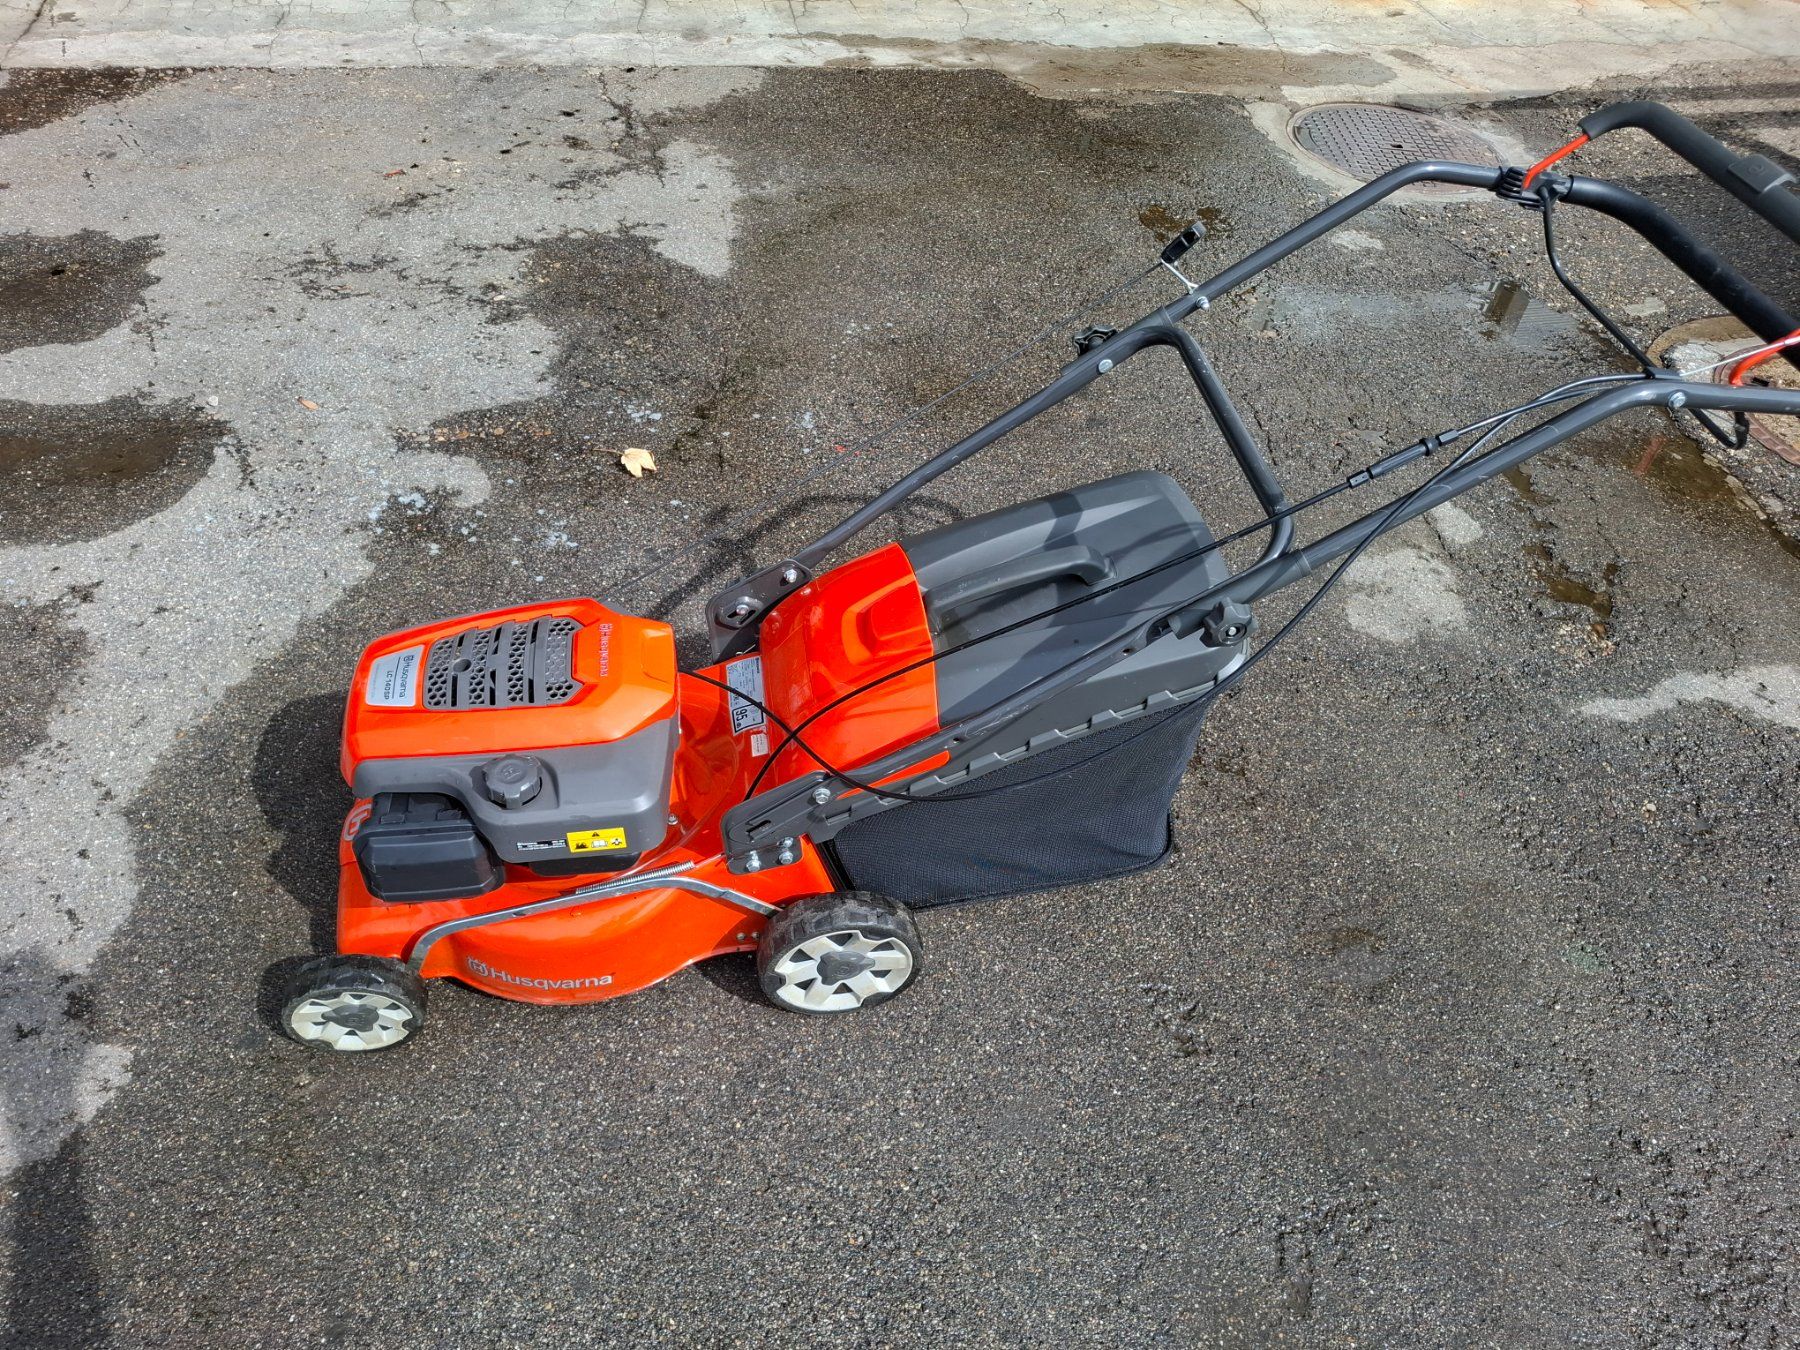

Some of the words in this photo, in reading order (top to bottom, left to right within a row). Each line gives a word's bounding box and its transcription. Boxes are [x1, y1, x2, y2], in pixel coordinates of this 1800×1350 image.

[399, 662, 413, 697] Husqvarna
[735, 708, 748, 722] 95
[490, 967, 613, 990] Husqvarna
